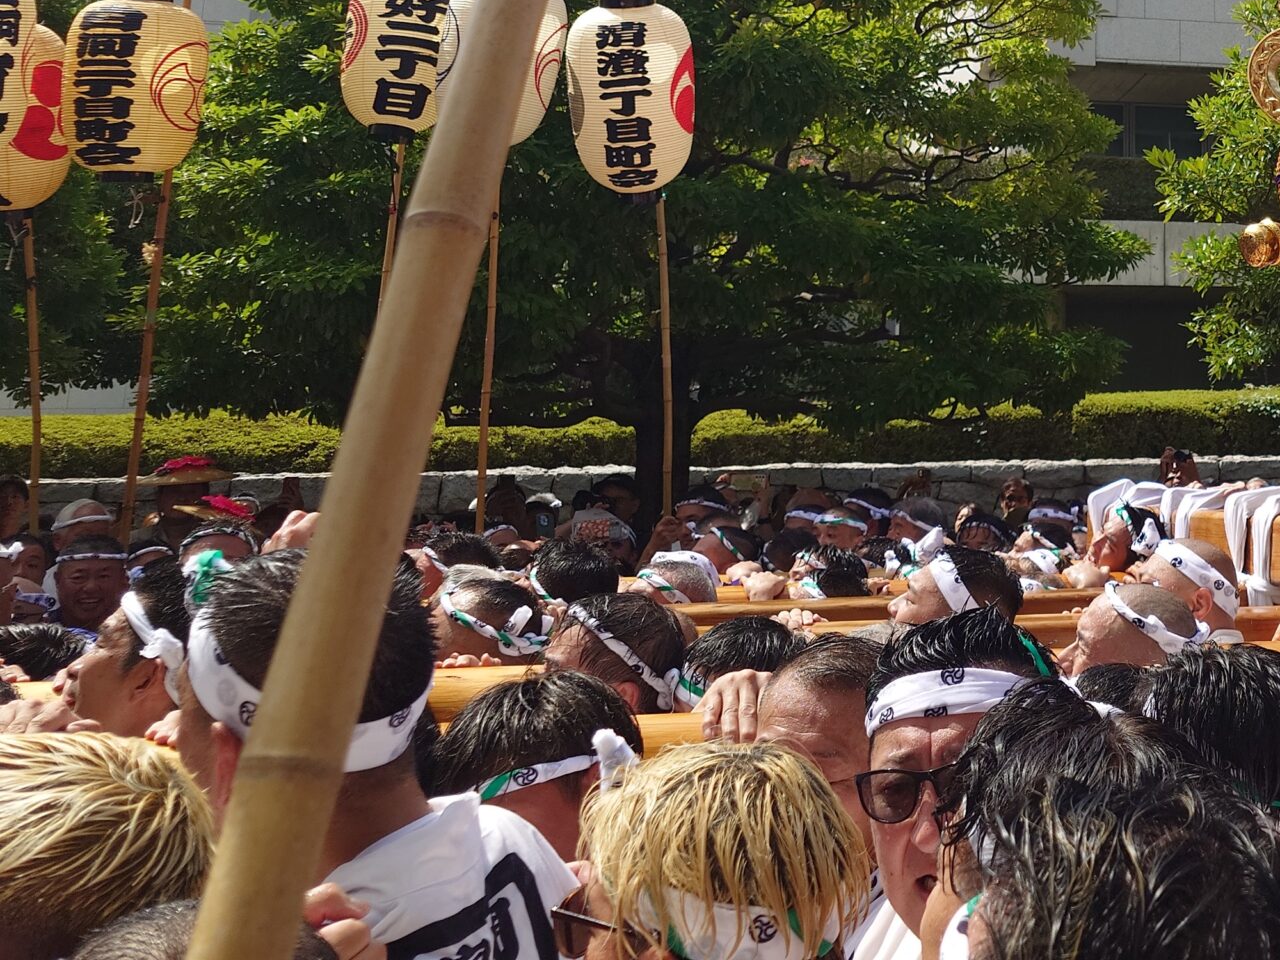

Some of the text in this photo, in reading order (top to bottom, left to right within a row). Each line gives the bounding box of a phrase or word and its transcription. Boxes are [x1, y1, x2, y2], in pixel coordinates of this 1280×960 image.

[595, 21, 659, 187] 清澄一丁目町会
